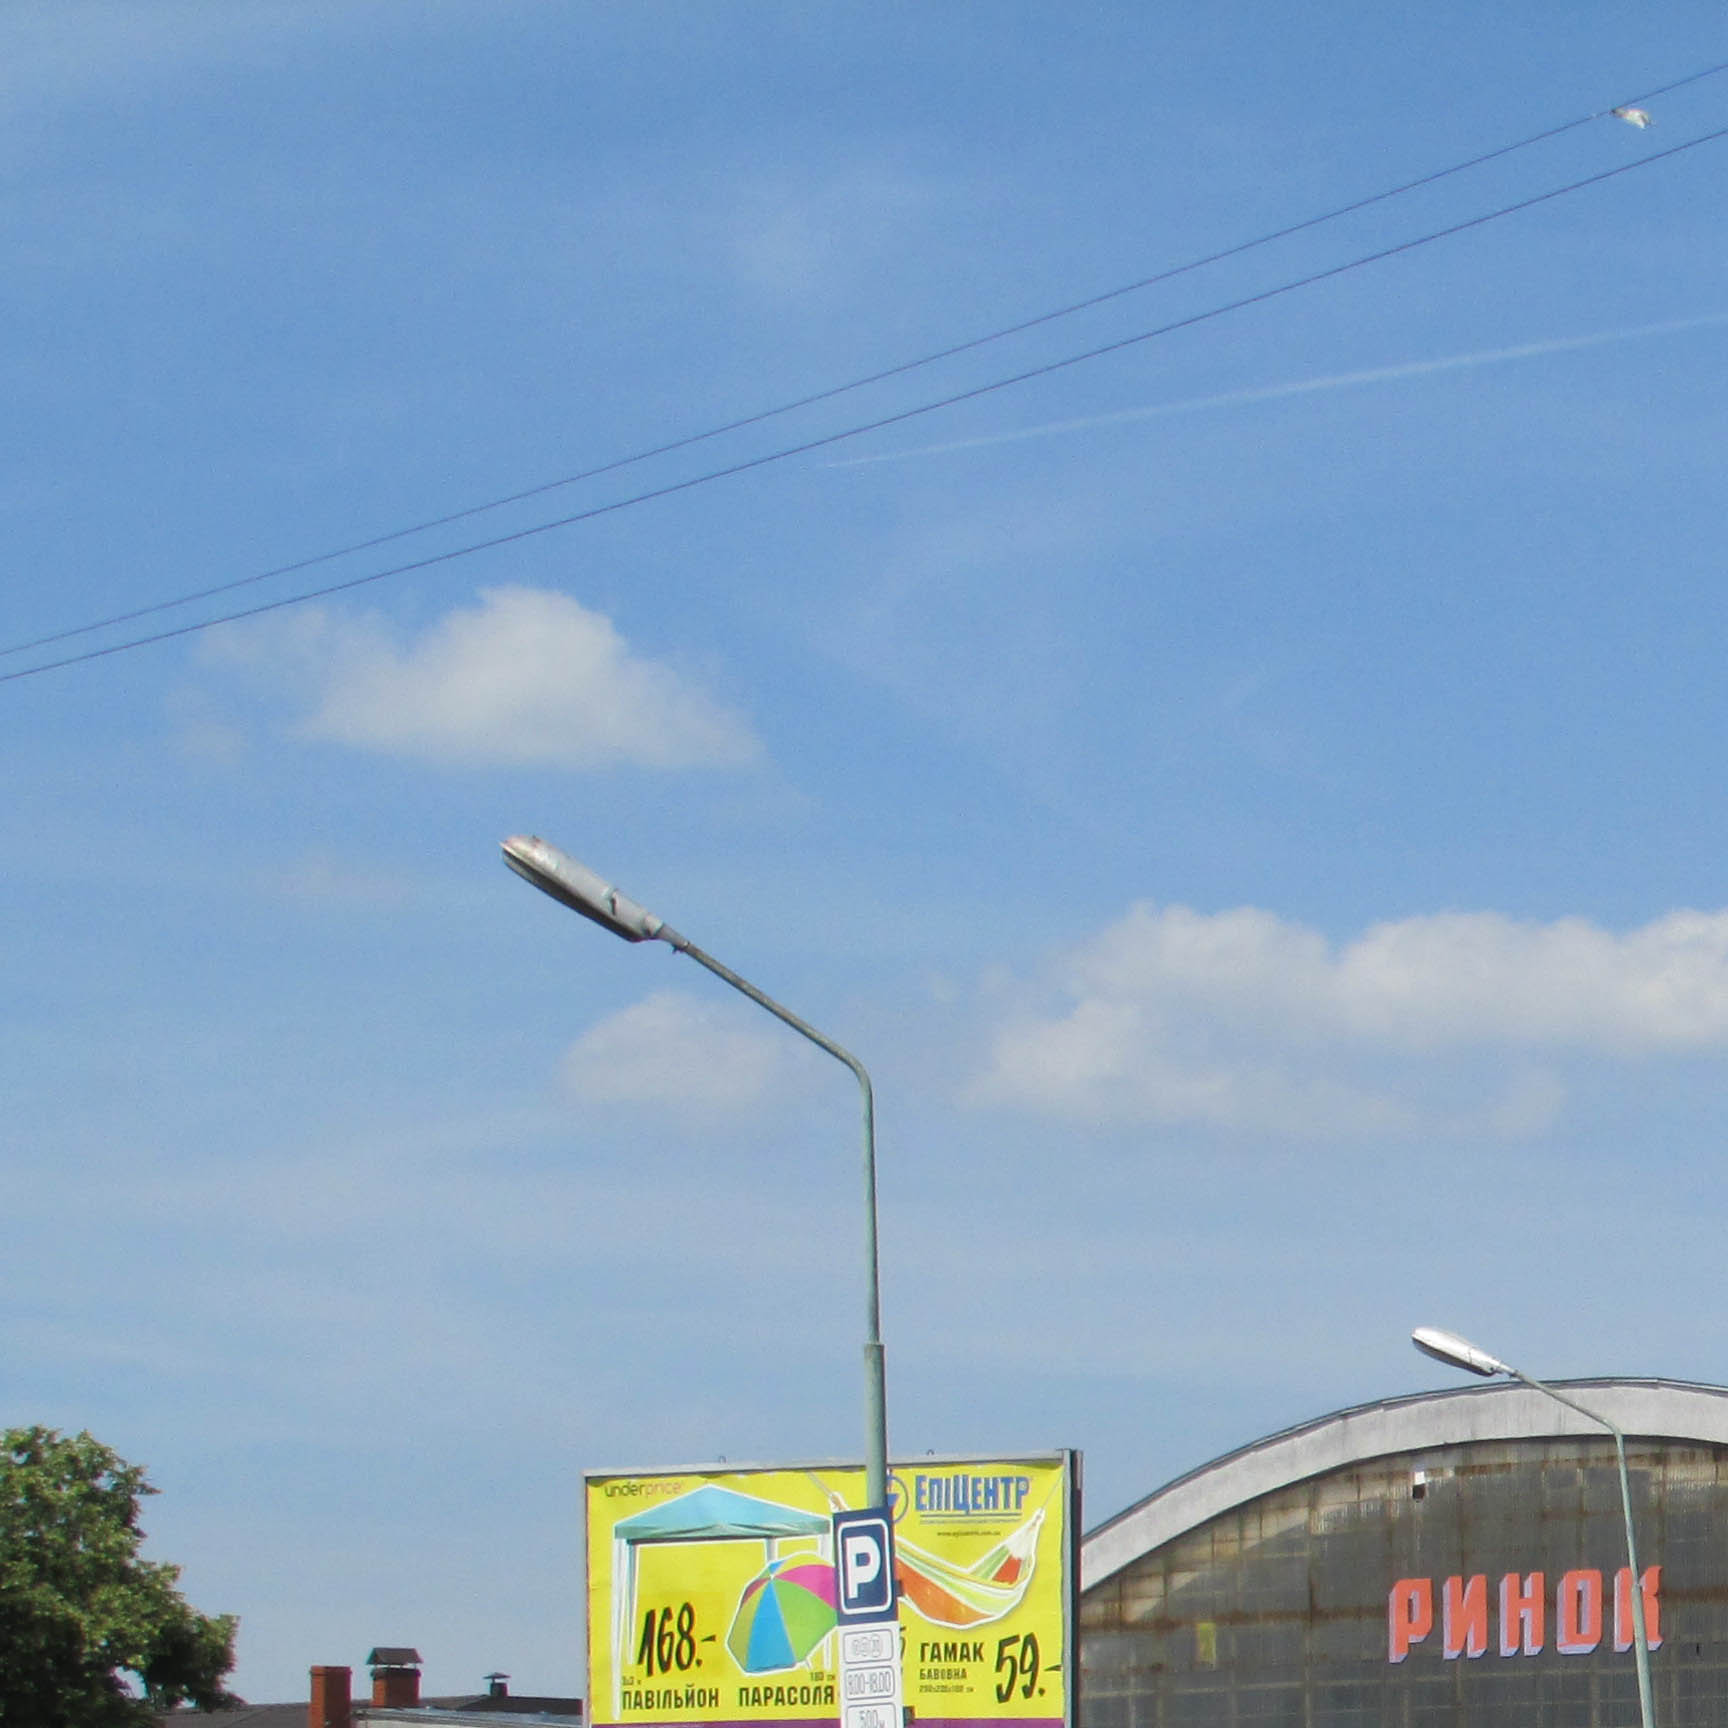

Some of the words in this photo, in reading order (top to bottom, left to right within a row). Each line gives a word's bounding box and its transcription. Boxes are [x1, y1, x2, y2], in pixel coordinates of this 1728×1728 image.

[915, 1475, 1029, 1515] ЕПІЦЕНТР
[846, 1535, 880, 1599] P
[1389, 1565, 1663, 1663] РИНОК
[920, 1642, 984, 1663] ГАМАК
[622, 1684, 719, 1710] ПАВІЛЬЙОН
[739, 1685, 835, 1707] ПАРАСОЛЯ
